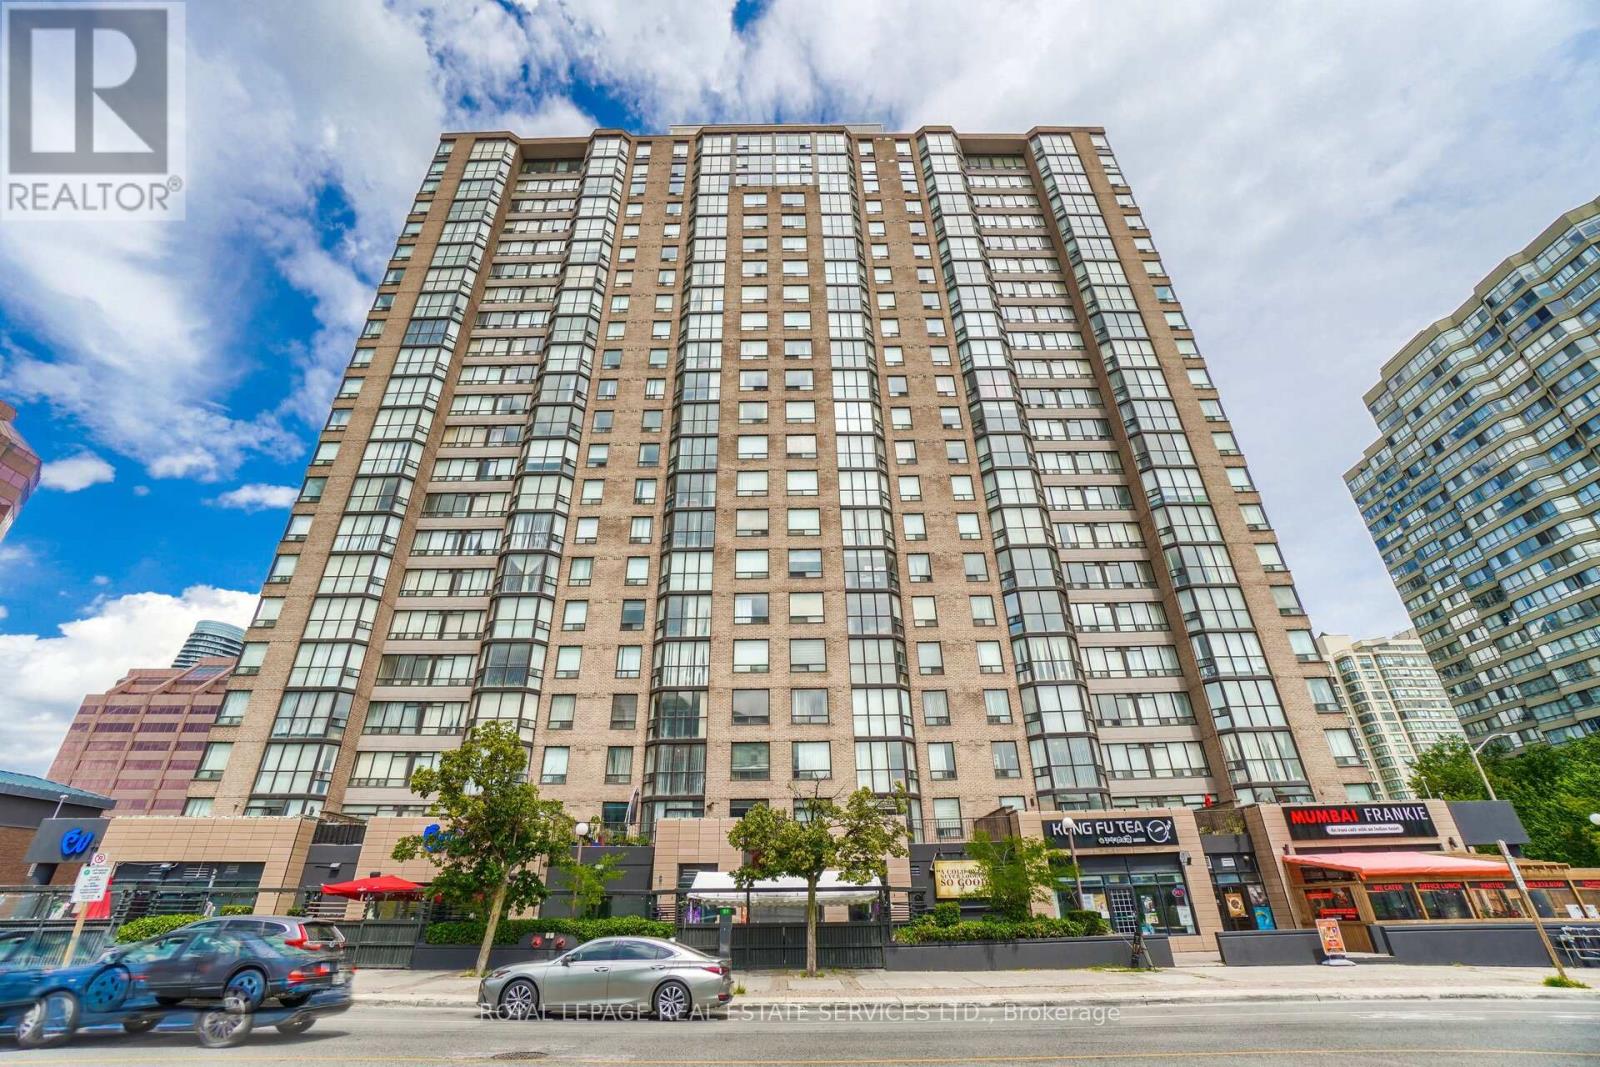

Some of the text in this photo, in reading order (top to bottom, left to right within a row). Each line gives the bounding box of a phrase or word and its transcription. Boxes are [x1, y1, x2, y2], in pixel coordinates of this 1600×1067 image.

[1290, 806, 1428, 824] MUMBAI FRANKIE
[1095, 821, 1114, 835] FU
[1115, 820, 1144, 834] TEA
[941, 879, 954, 887] SO
